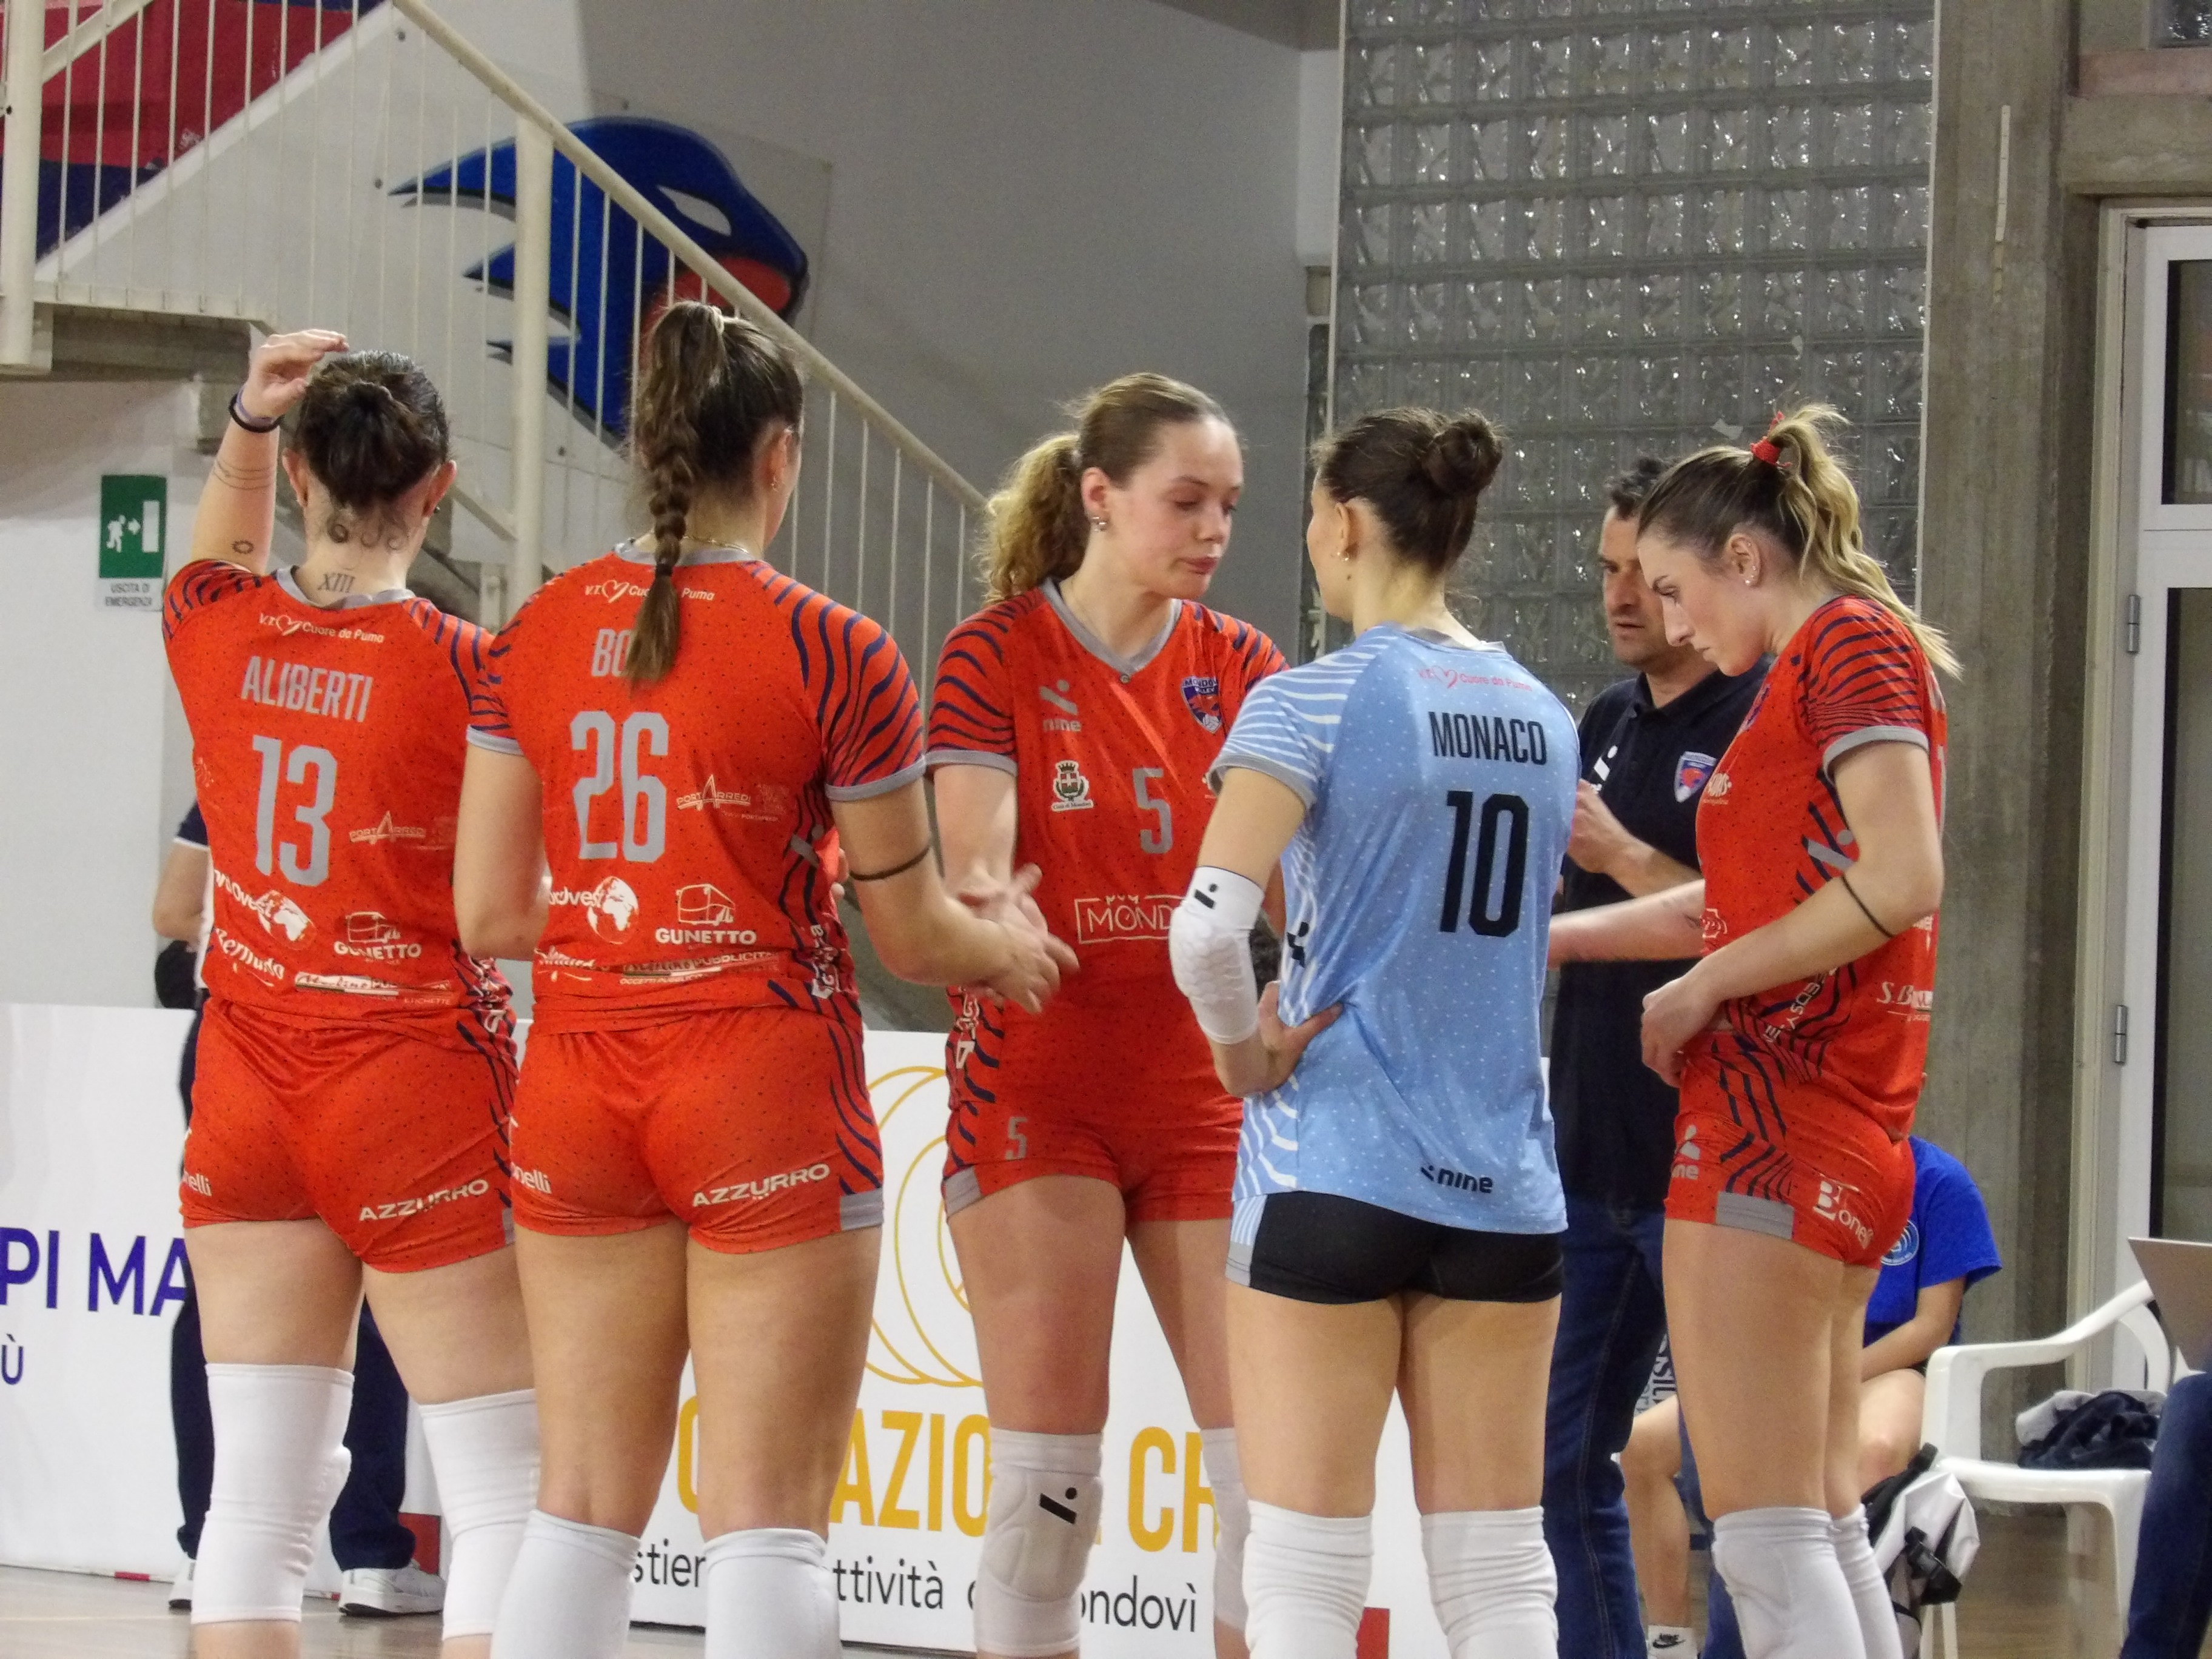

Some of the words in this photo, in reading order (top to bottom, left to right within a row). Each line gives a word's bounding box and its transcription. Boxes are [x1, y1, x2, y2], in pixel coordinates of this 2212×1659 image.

[318, 572, 356, 593] XIII
[682, 588, 716, 601] Puma
[303, 622, 336, 637] Cuore
[354, 629, 385, 643] Puma
[591, 628, 635, 677] BO
[241, 655, 374, 723] ALIBERTI
[1428, 711, 1547, 766] MONACO
[252, 735, 338, 886] 13
[569, 711, 669, 863] 26
[1131, 768, 1173, 854] 5
[1439, 790, 1529, 938] 10
[655, 927, 757, 946] GUNETTO
[1087, 905, 1173, 933] MOND
[1005, 1117, 1028, 1161] 5
[511, 1162, 552, 1195] nelli
[692, 1163, 831, 1207] AZZURRO
[1437, 1168, 1493, 1194] nine
[87, 1233, 189, 1316] MA
[0, 1335, 24, 1386] Ù
[833, 1555, 943, 1610] ttività
[1081, 1575, 1196, 1632] ndovì
